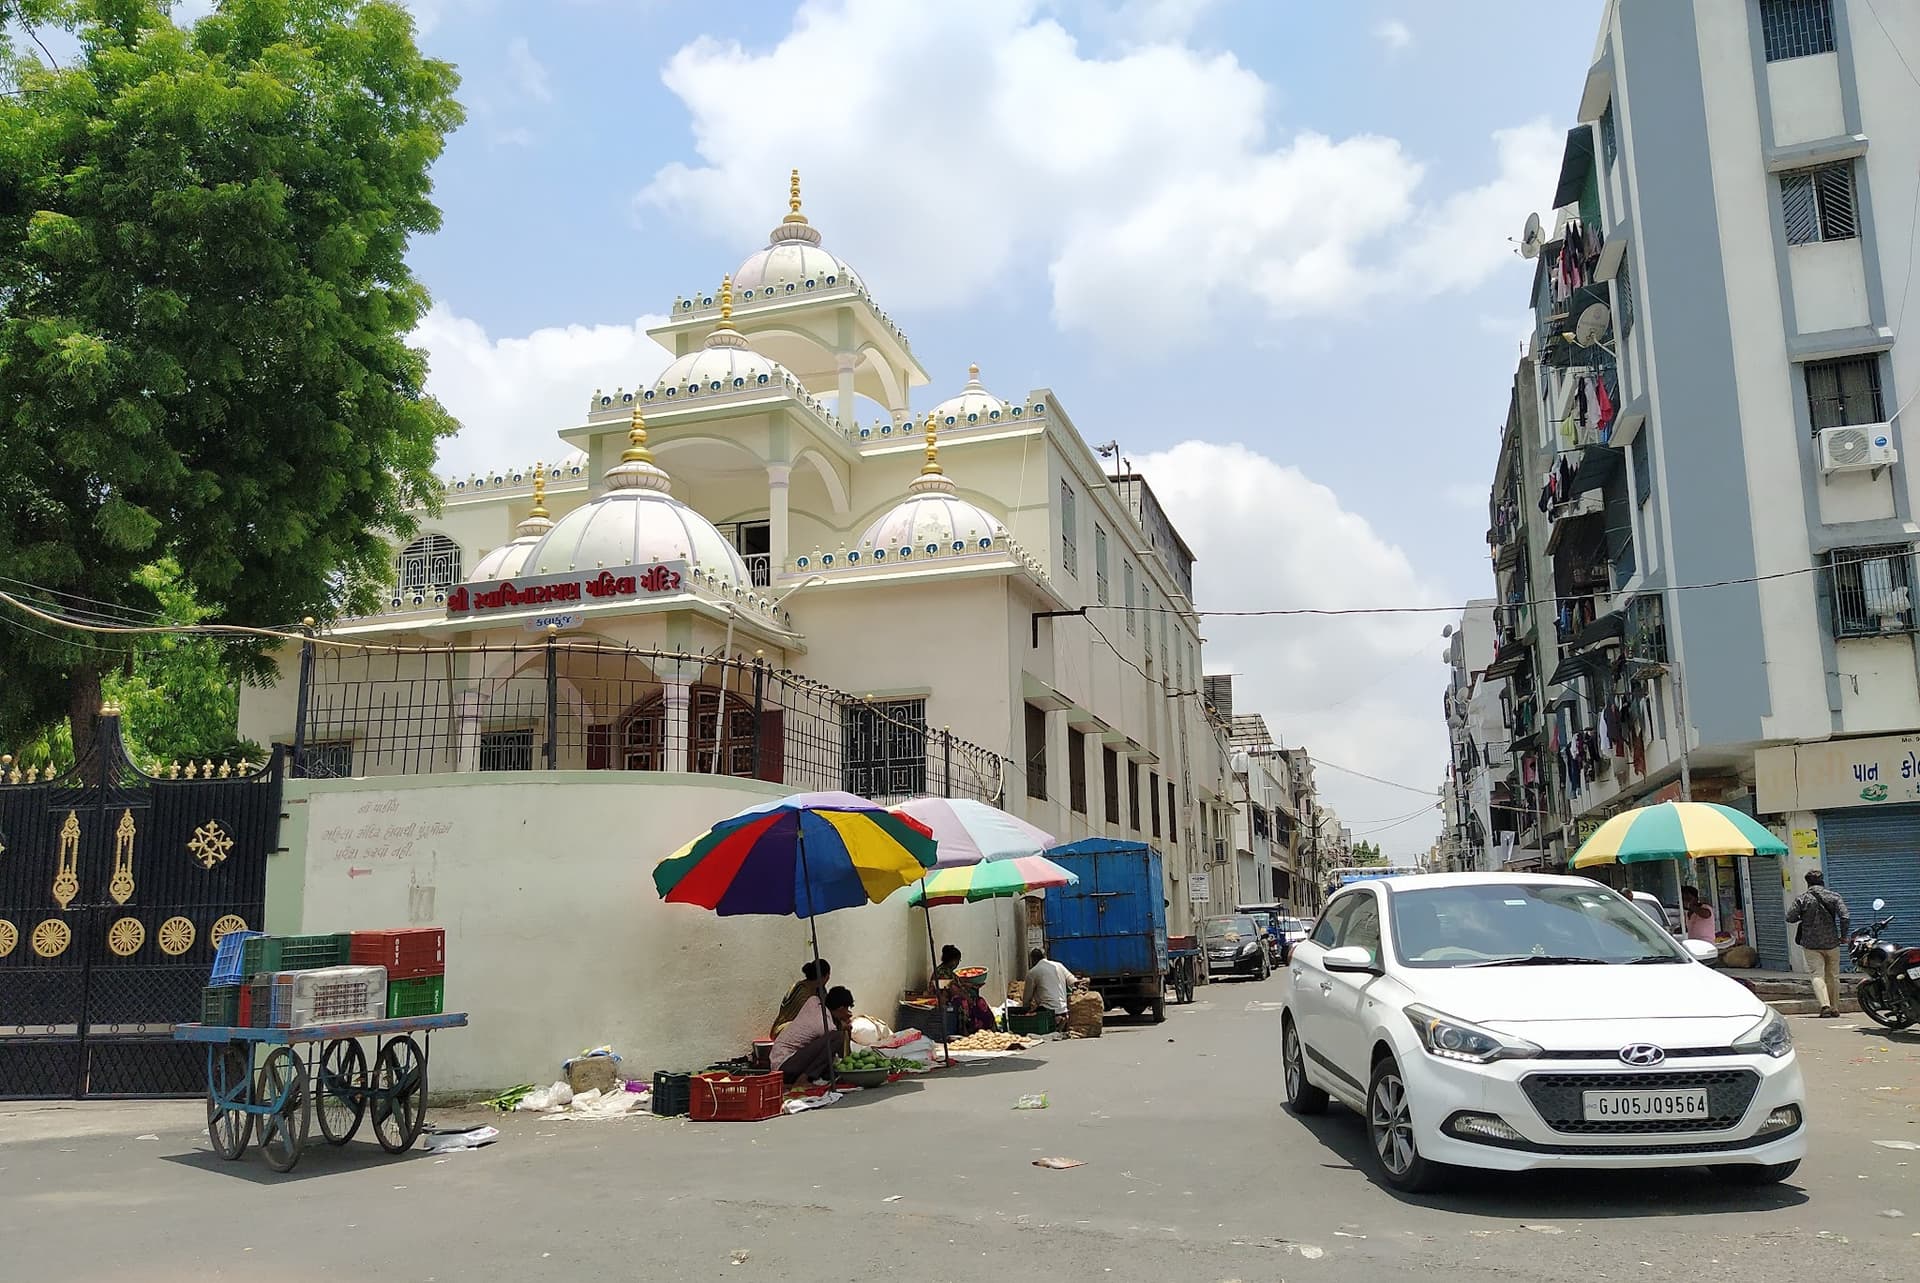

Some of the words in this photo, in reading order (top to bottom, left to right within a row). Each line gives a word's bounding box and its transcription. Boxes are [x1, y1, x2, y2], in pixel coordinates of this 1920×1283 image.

[447, 586, 470, 612] શ્રી
[473, 581, 581, 610] સ્વામિનારાયણ
[585, 571, 636, 597] મહિલા
[640, 565, 681, 592] મંદિર
[1853, 763, 1879, 783] પાન
[1599, 1095, 1705, 1115] GJ05JQ9564
